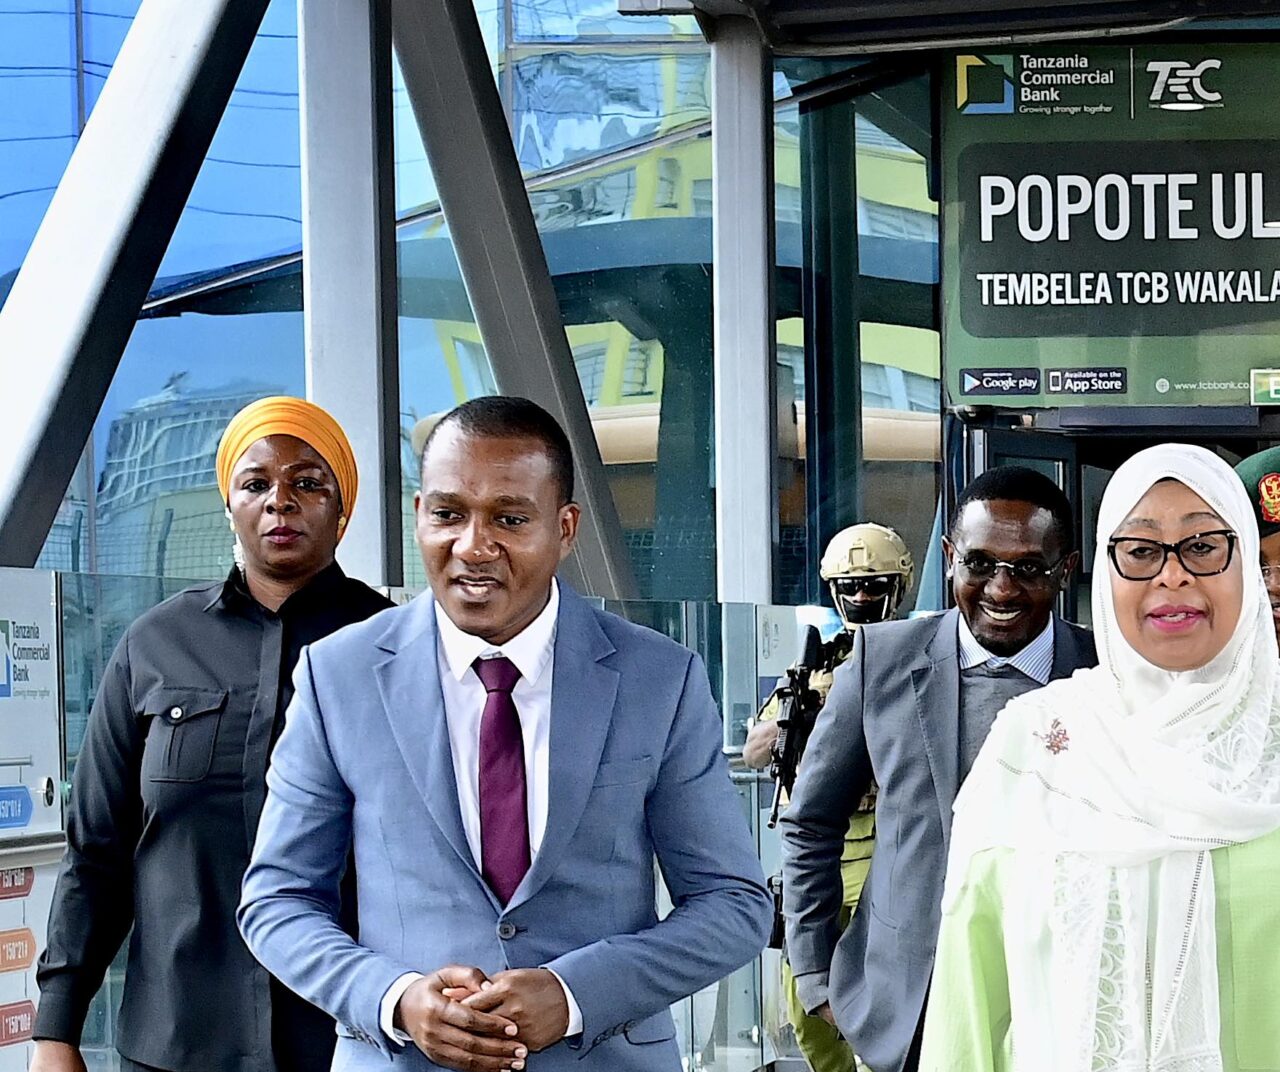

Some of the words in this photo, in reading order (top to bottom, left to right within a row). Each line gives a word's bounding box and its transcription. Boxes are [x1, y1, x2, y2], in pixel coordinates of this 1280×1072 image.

[1020, 54, 1089, 69] Tanzania
[1020, 70, 1114, 85] Commercial
[1020, 87, 1060, 101] Bank
[1019, 104, 1051, 115] Growing
[1053, 105, 1082, 115] stronger
[1083, 104, 1113, 115] together
[979, 173, 1199, 242] POPOTE
[977, 271, 1113, 305] TEMBELEA
[1116, 271, 1169, 304] TCB
[982, 377, 1017, 390] Google
[1019, 377, 1038, 390] play
[1064, 378, 1089, 392] App
[1091, 378, 1122, 390] Store
[11, 621, 40, 639] Tanzania
[12, 642, 50, 660] Commercial
[12, 663, 30, 681] Bank
